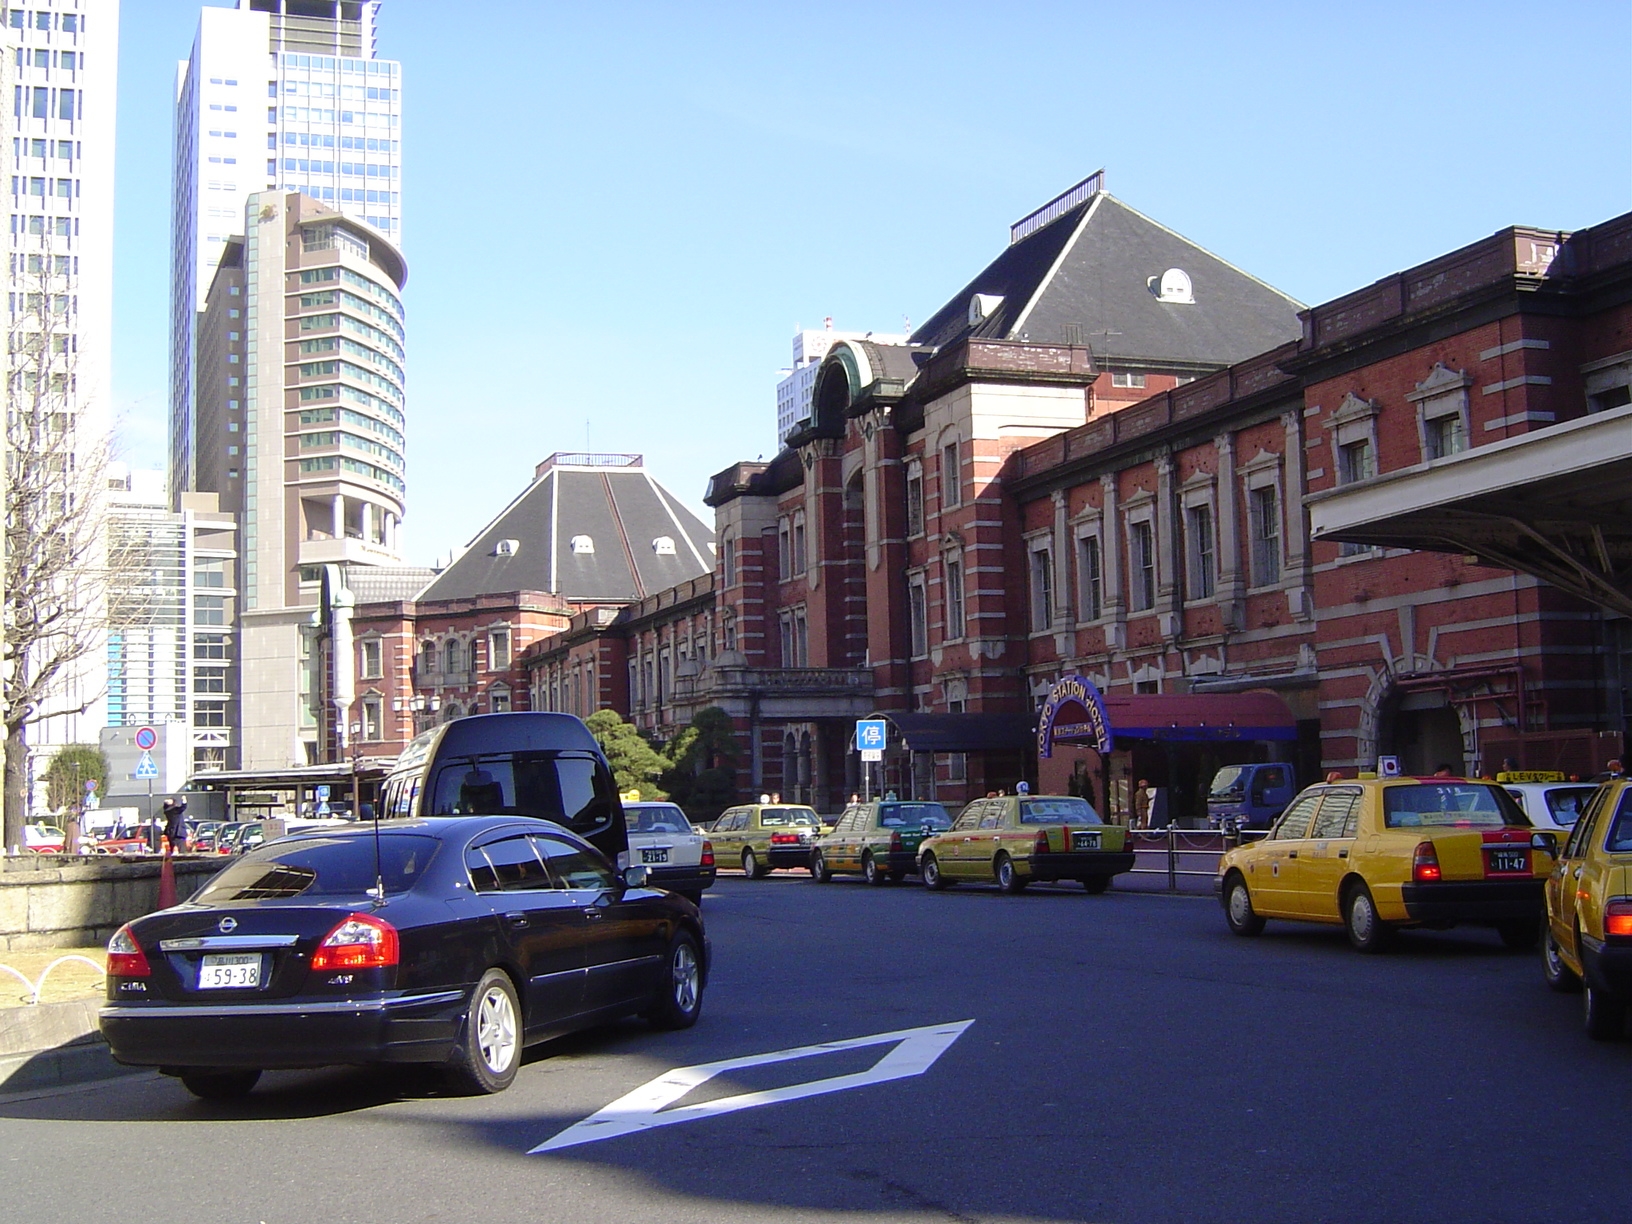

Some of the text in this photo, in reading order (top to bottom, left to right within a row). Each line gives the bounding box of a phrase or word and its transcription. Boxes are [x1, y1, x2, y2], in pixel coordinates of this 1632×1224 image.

[1039, 681, 1107, 755] TOKYO STATION HOTEL
[861, 725, 881, 745] 停
[1498, 858, 1525, 869] 11-47
[214, 967, 257, 985] 59-38
